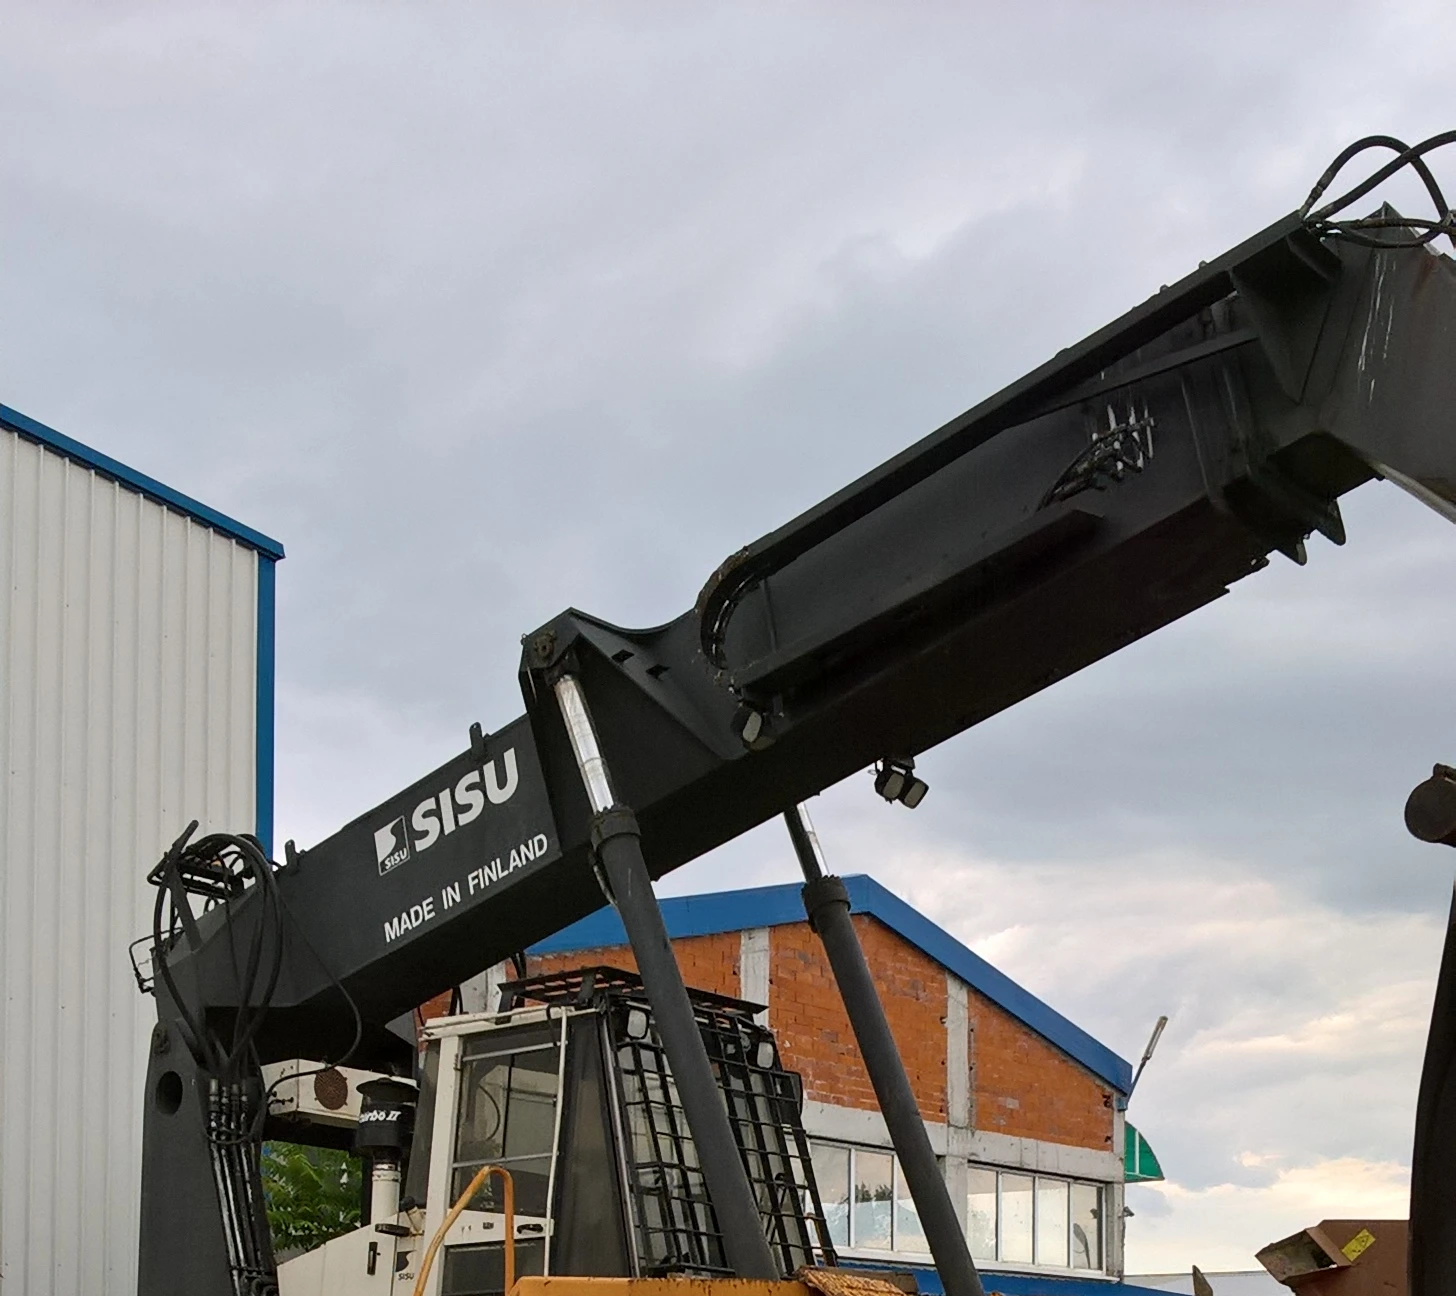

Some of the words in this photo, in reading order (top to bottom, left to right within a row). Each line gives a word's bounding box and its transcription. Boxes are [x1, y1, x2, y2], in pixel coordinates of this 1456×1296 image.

[411, 747, 519, 853] SISU
[383, 896, 436, 943] MADE
[441, 881, 461, 910] IN
[467, 833, 548, 895] FINLAND
[384, 847, 408, 870] SISU
